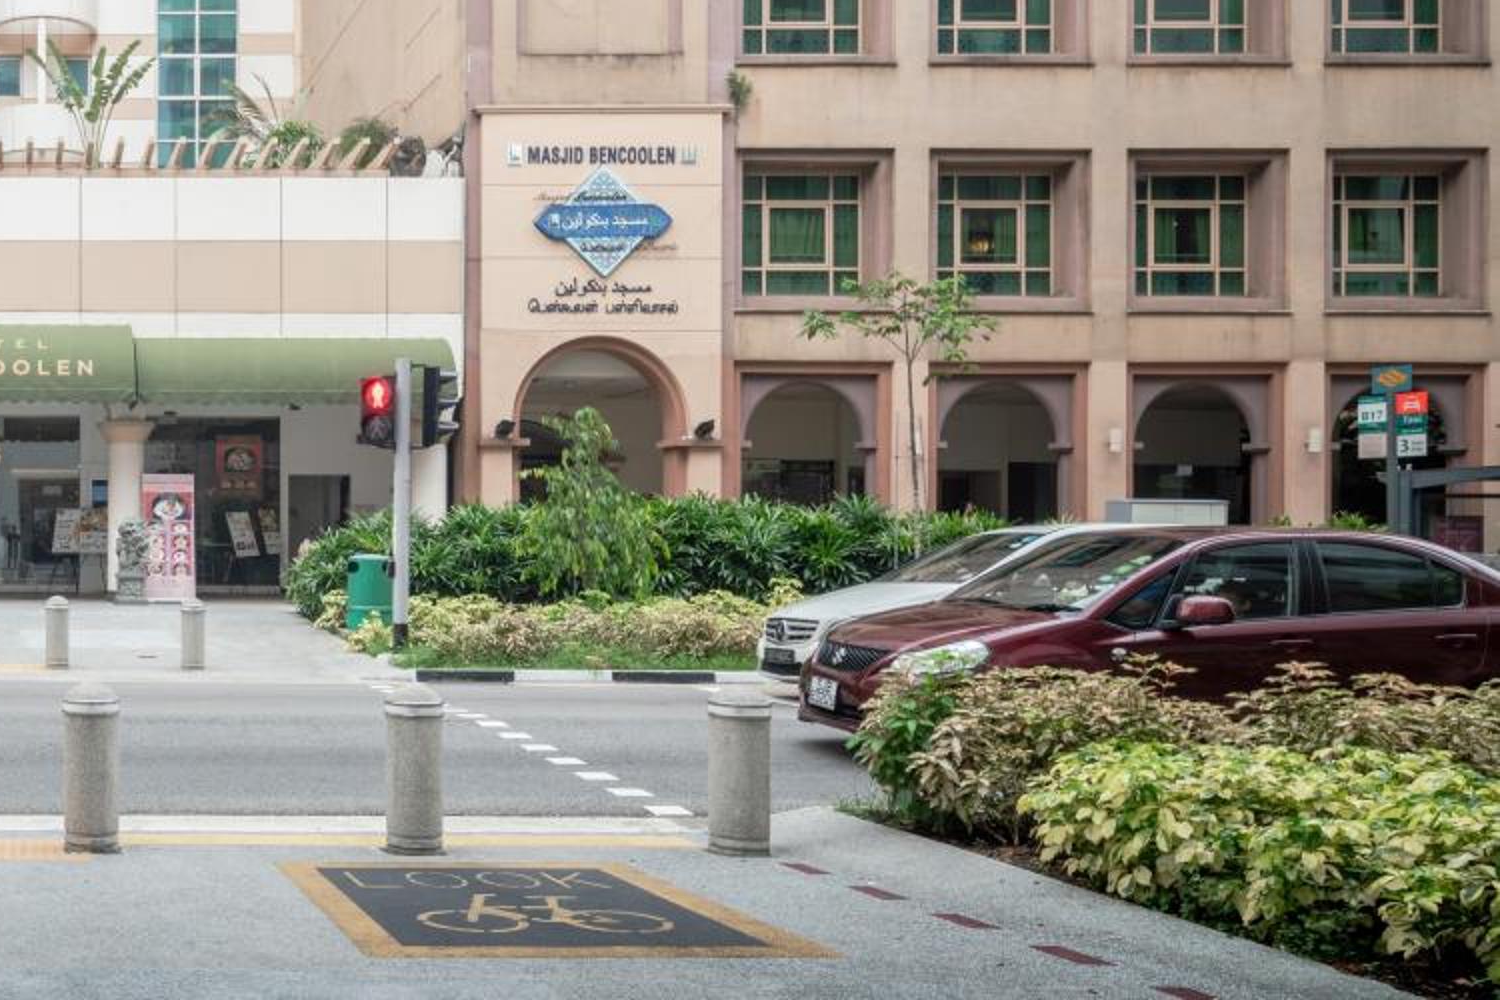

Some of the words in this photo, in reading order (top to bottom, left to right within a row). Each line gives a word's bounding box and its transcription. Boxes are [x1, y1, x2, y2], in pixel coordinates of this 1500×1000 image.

[527, 146, 584, 165] MASJID
[589, 146, 676, 165] BENCOOLEN
[1399, 439, 1410, 453] 3
[343, 870, 612, 890] LOOK
